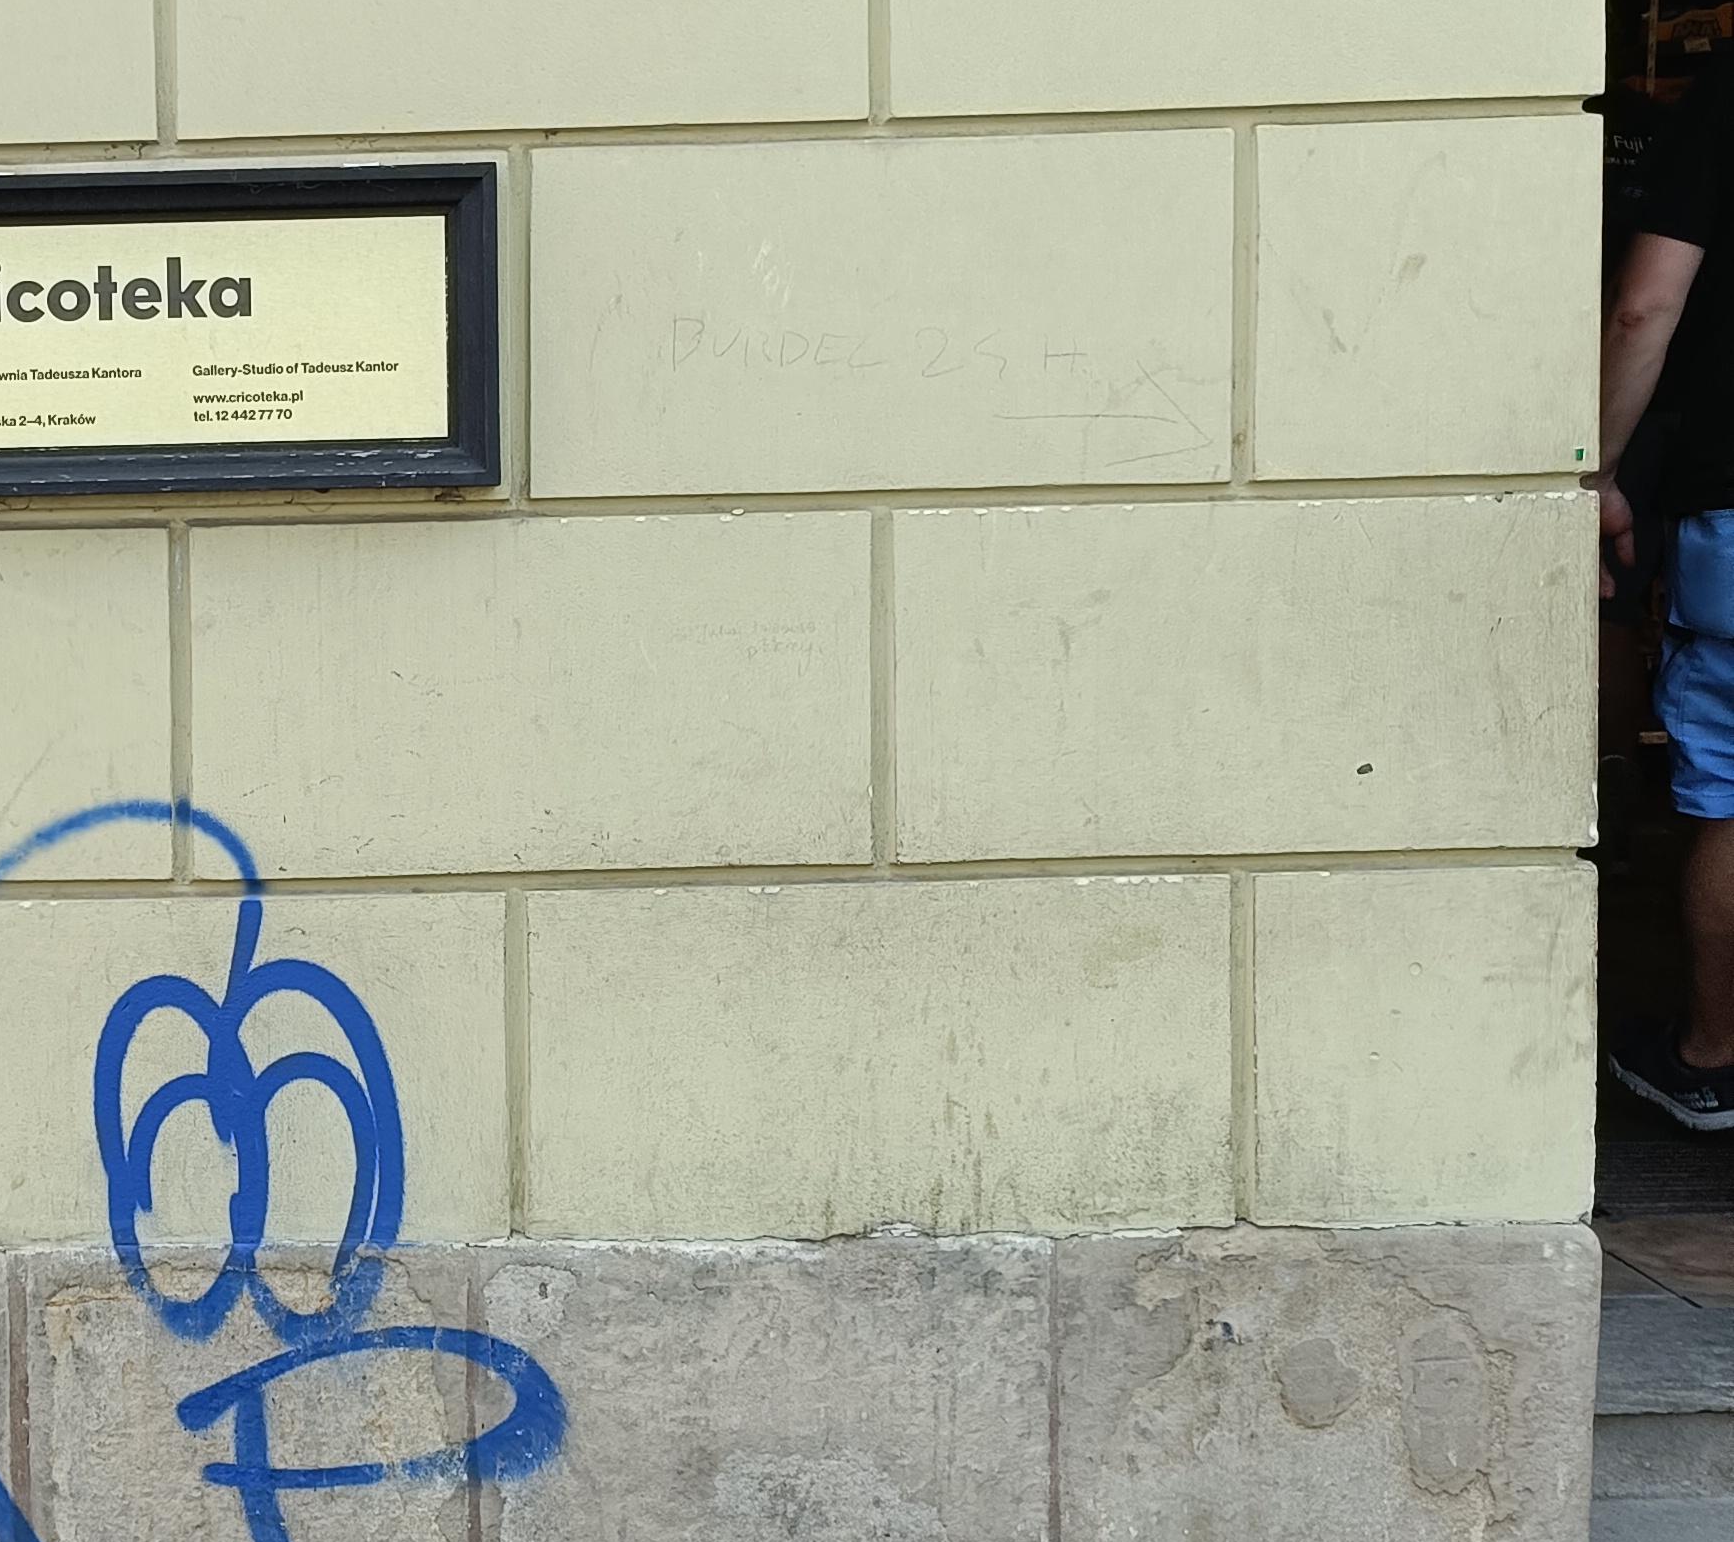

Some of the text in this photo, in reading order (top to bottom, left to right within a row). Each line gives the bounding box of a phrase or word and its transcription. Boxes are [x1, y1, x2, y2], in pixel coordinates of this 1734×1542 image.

[30, 368, 90, 380] Tadeusza
[91, 367, 142, 379] Kantora
[192, 360, 400, 378] Gallery-Studio of Tadeusz Kantor
[192, 390, 304, 404] www.cricoteka.pl
[47, 413, 97, 426] Kraków
[193, 408, 293, 422] tel. 12 442 77 70
